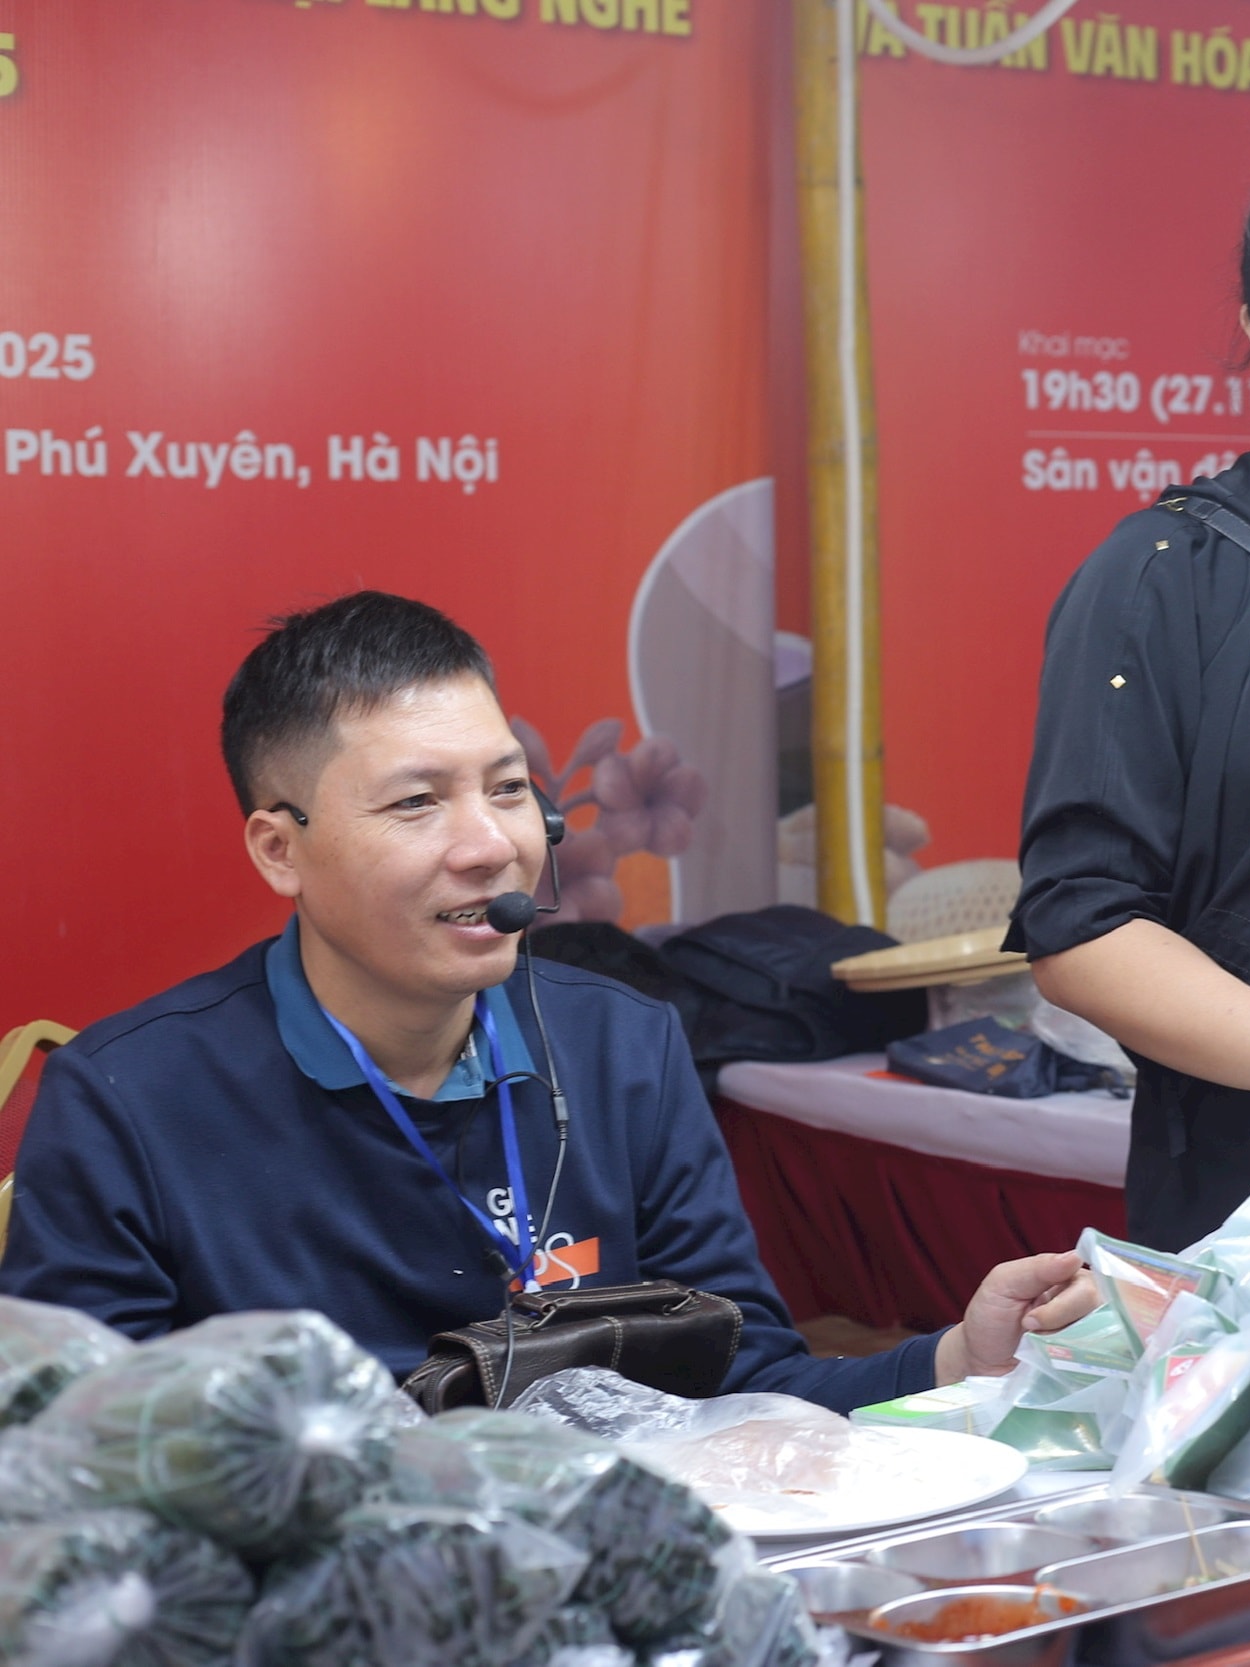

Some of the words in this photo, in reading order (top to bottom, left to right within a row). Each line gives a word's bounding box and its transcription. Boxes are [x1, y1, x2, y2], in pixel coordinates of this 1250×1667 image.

[1062, 14, 1157, 81] VĂN
[1017, 330, 1069, 358] Khai
[1021, 370, 1141, 412] 19h30
[5, 424, 108, 477] Phú
[125, 428, 312, 489] Xuyên,
[327, 431, 401, 482] Hà
[415, 434, 499, 494] Nội
[1022, 448, 1098, 491] Sân
[1109, 450, 1182, 503] vận
